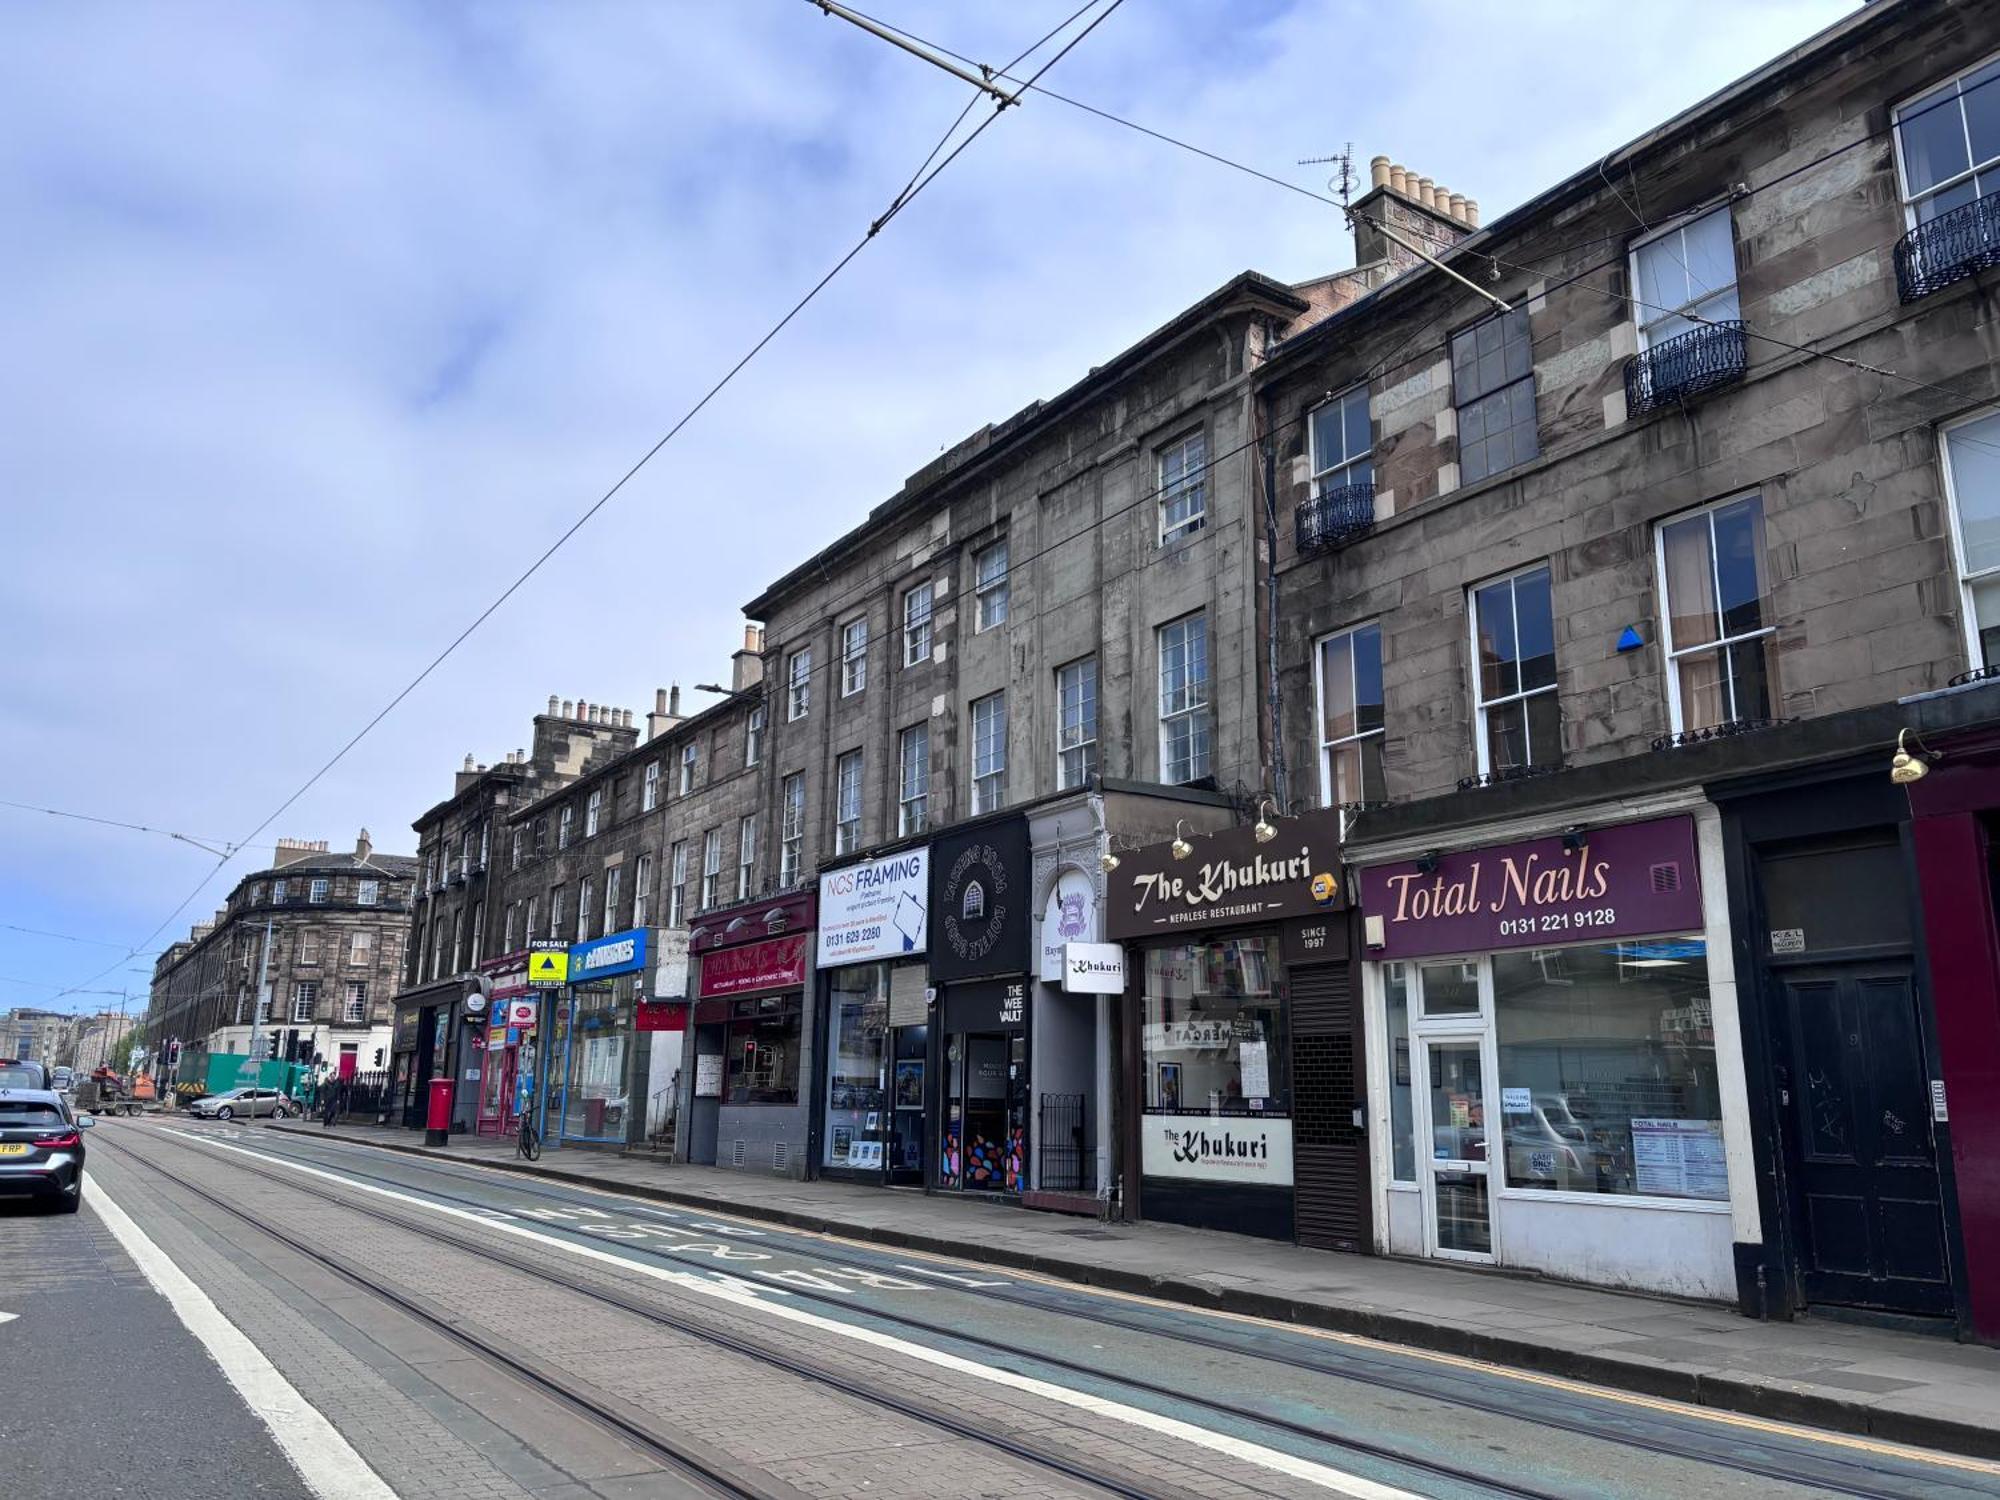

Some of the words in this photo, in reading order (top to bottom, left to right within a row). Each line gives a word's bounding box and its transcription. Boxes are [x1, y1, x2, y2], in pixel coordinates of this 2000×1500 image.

[827, 873, 854, 896] NCS
[856, 856, 920, 890] FRAMING
[1132, 872, 1183, 911] The
[1186, 847, 1311, 905] Khukuri
[1386, 864, 1479, 922] Total
[1491, 846, 1610, 912] Nails
[1170, 910, 1207, 924] NEPALESE
[1210, 903, 1264, 918] RESTAURANT
[1500, 918, 1537, 936] 0131
[1541, 915, 1569, 931] 221
[1574, 908, 1616, 929] 9128
[1301, 927, 1327, 938] SINCE
[549, 940, 569, 948] SALE
[826, 935, 844, 947] 0131
[1304, 938, 1325, 949] 1997
[1073, 960, 1121, 973] Khukuri
[1007, 985, 1023, 997] THE
[1004, 998, 1023, 1009] WEE
[999, 1010, 1023, 1023] VAULT
[2, 1144, 22, 1153] FRP
[1163, 1129, 1179, 1141] The
[1173, 1130, 1267, 1163] Khukuri
